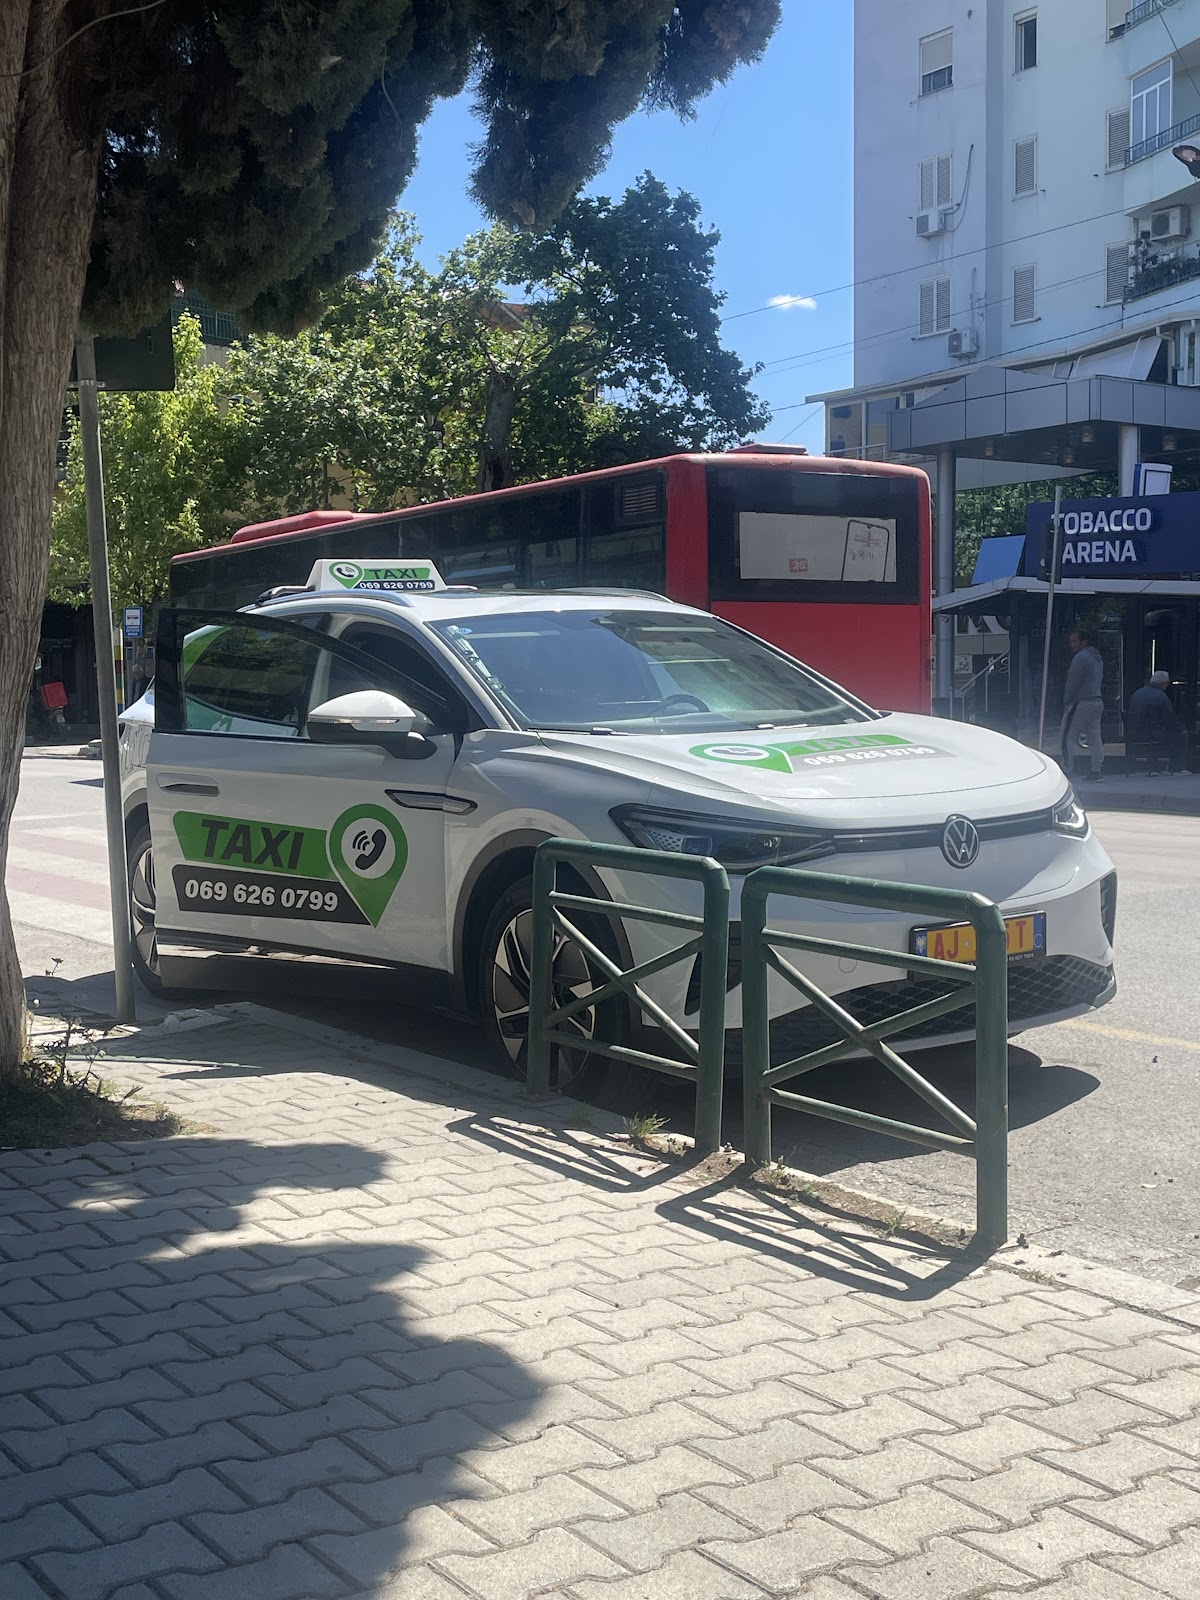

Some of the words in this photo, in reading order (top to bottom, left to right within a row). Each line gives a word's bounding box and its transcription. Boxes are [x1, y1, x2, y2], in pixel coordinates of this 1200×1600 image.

[1061, 539, 1137, 564] ARENA
[368, 568, 418, 579] TAXI
[359, 581, 381, 589] 069
[383, 581, 404, 589] 626
[406, 581, 434, 589] 0799
[799, 735, 887, 751] TAXI
[803, 753, 847, 766] 069
[845, 750, 888, 760] 626
[884, 746, 936, 757] 0799
[202, 819, 304, 869] TAXI
[184, 878, 228, 901] 069
[233, 883, 276, 906] 626
[280, 887, 339, 912] 0799
[934, 930, 958, 959] AJ
